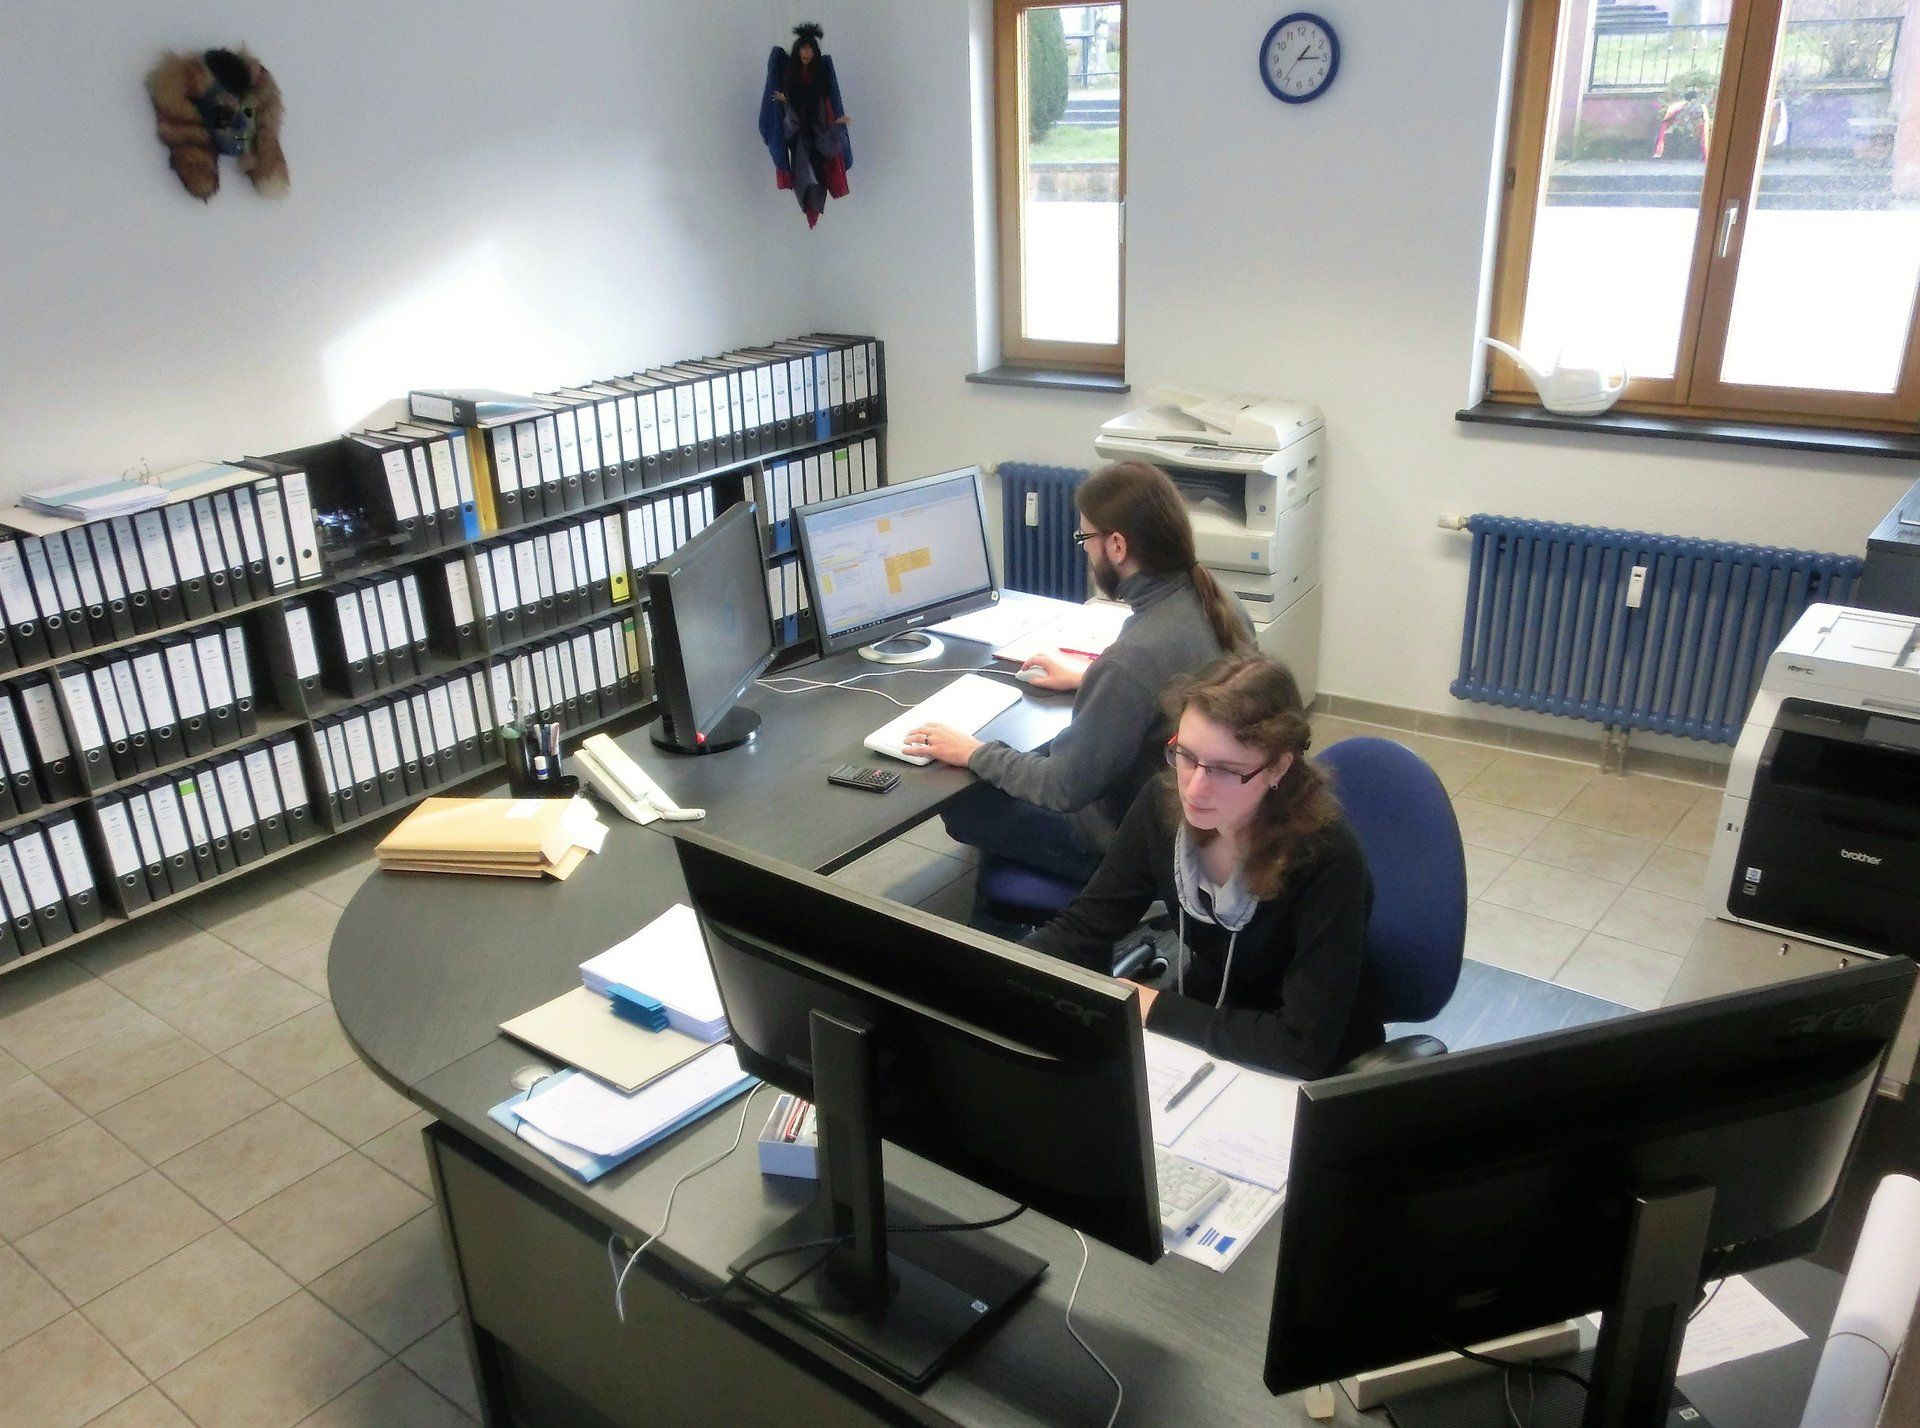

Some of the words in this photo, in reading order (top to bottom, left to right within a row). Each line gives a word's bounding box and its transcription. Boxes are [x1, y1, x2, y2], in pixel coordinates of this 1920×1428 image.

[1286, 31, 1293, 40] 11
[1297, 26, 1306, 36] 12
[1278, 41, 1286, 51] 10
[1318, 40, 1324, 49] 2
[1273, 55, 1279, 64] 9
[1321, 53, 1327, 62] 3
[1317, 68, 1323, 76] 4
[1296, 80, 1302, 89] 6
[1308, 77, 1315, 87] 5
[1841, 848, 1883, 866] brother
